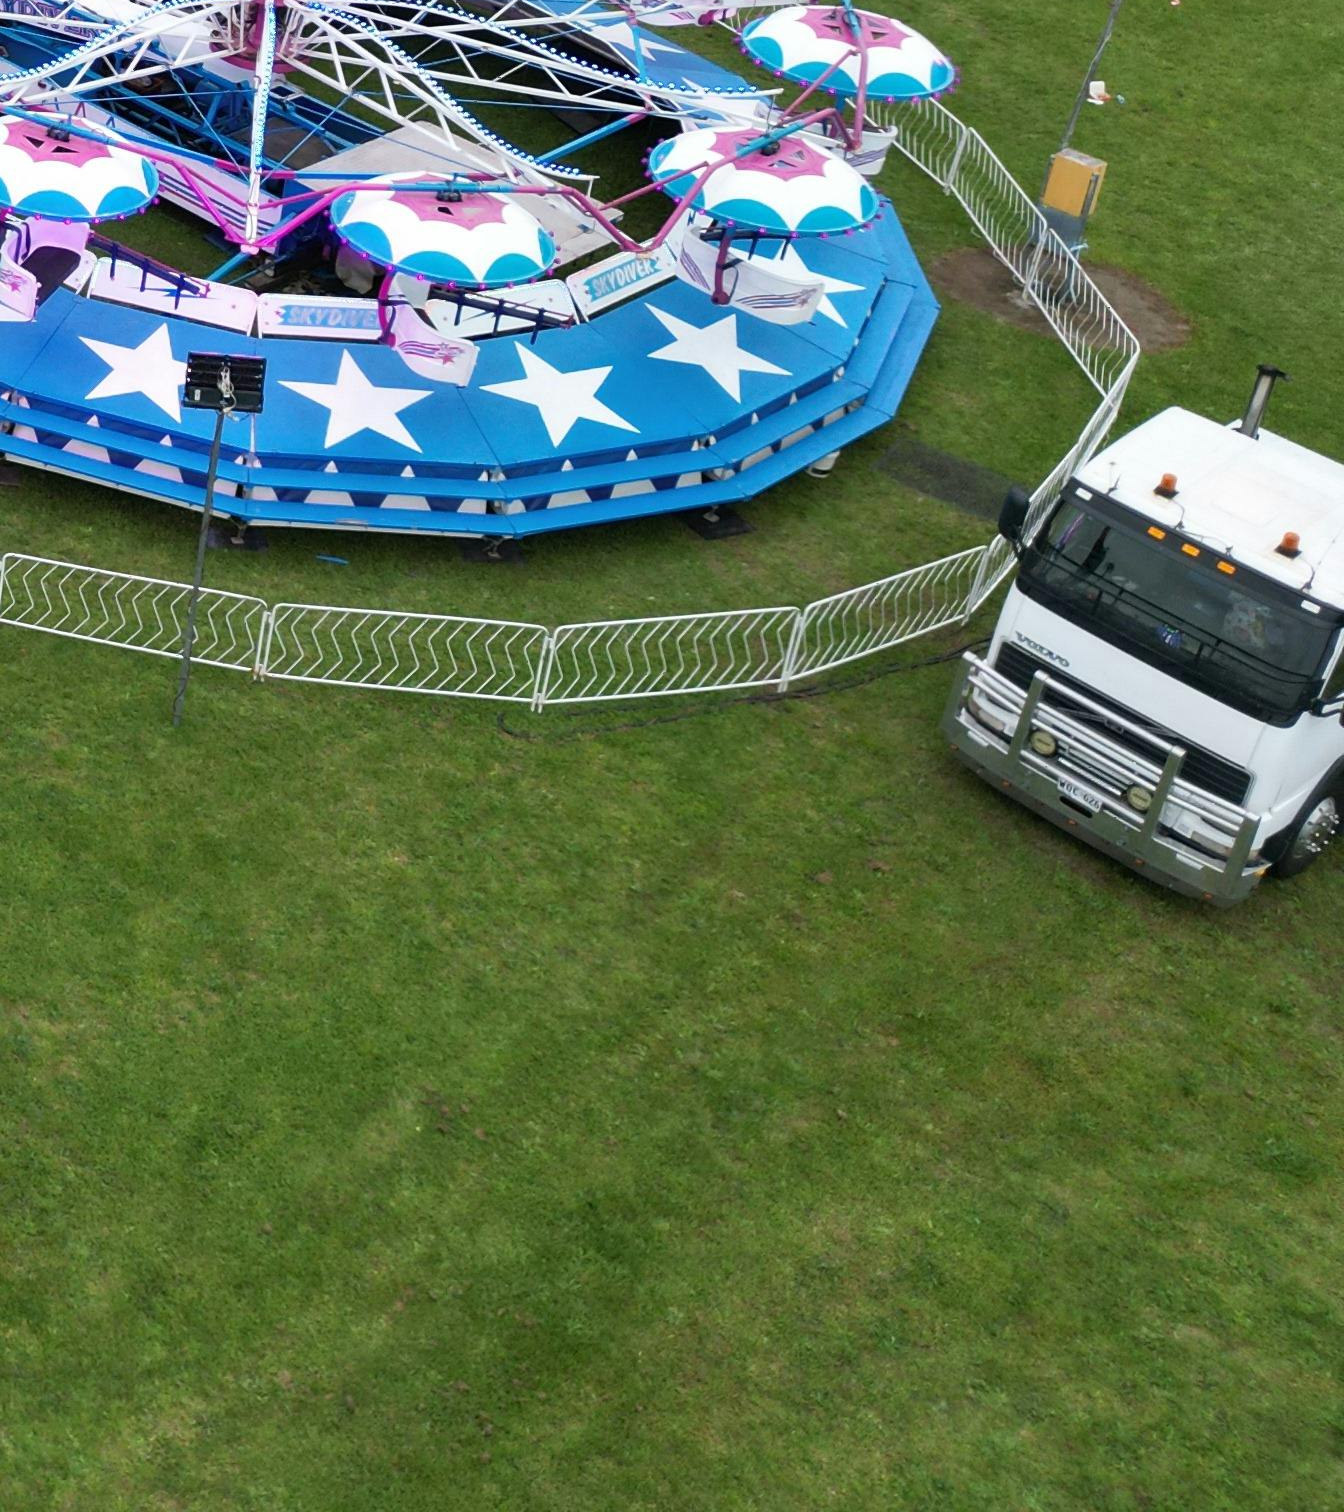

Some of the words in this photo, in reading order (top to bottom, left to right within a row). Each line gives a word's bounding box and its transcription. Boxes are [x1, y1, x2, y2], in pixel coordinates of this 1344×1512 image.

[591, 258, 656, 298] SKYDIVER
[288, 305, 380, 329] SKYDIVE
[1015, 630, 1070, 668] VOLVO
